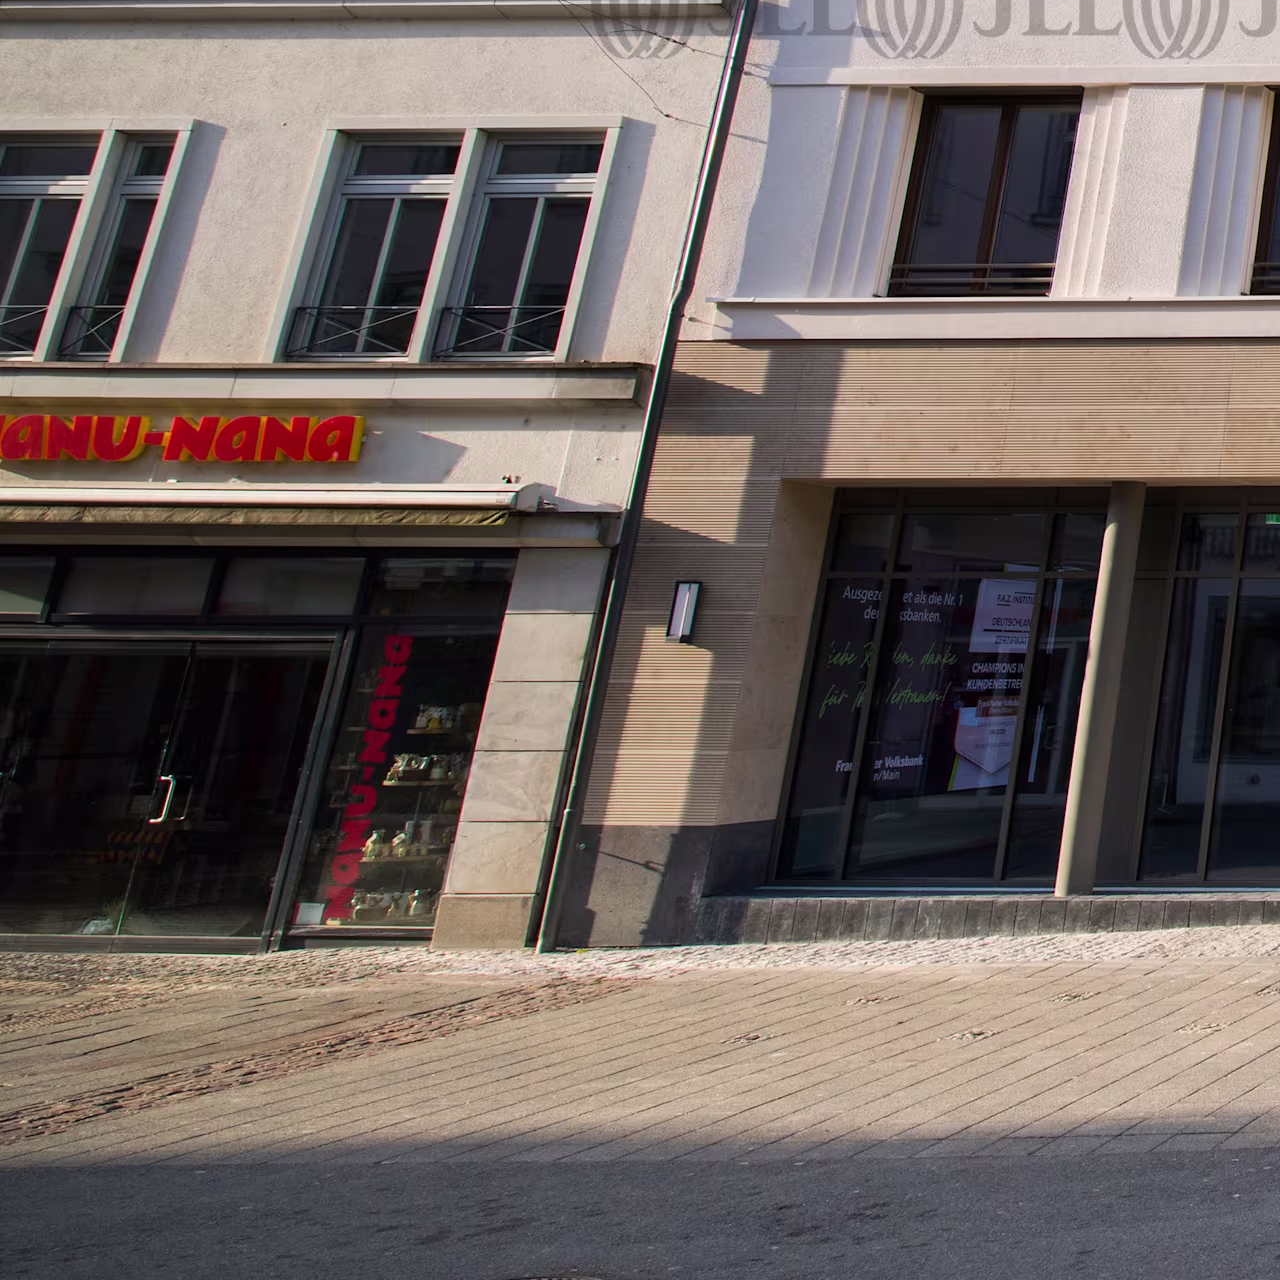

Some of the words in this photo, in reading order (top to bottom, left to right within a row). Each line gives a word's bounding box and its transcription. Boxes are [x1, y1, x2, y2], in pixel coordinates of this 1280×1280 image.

[914, 590, 926, 603] als
[928, 591, 942, 605] die
[958, 593, 963, 607] 1
[920, 640, 958, 672] danke
[971, 662, 1016, 673] CHAMPIONS
[818, 684, 848, 719] für
[884, 754, 924, 769] Volksbank
